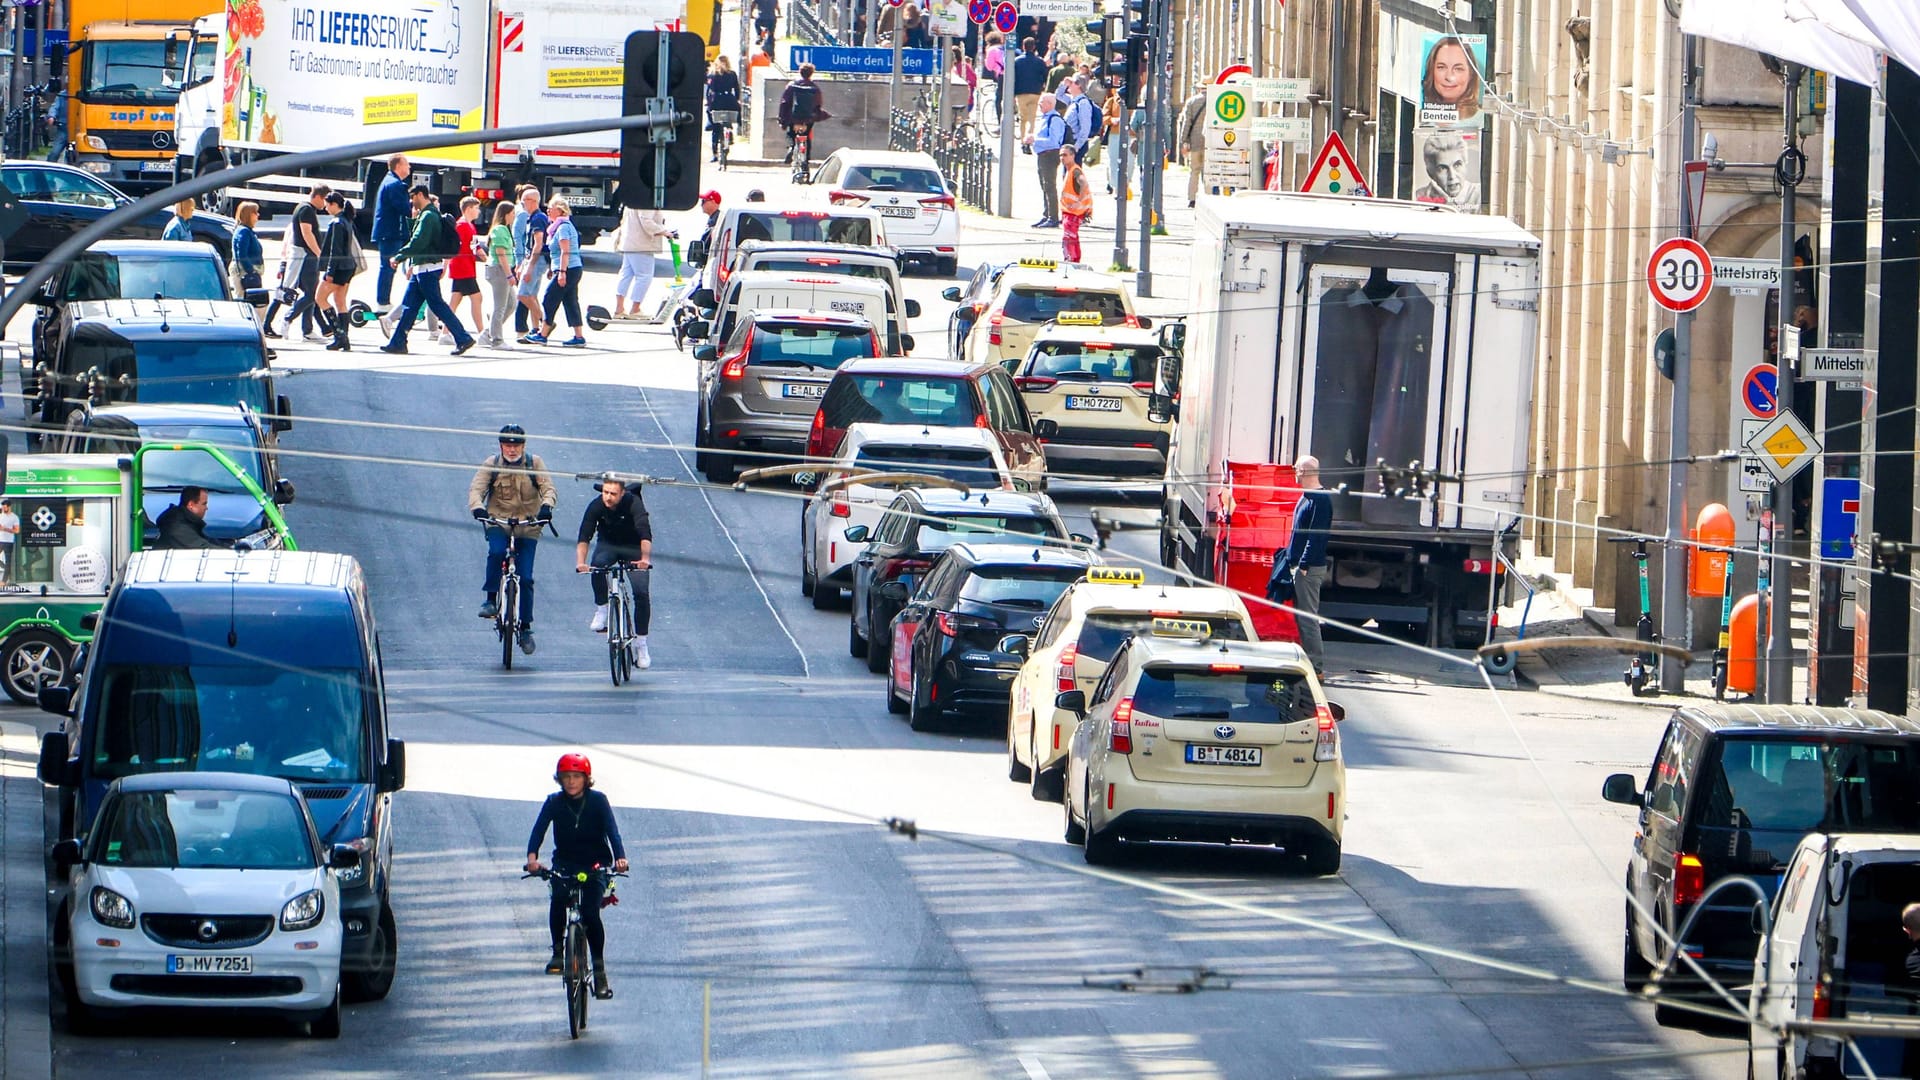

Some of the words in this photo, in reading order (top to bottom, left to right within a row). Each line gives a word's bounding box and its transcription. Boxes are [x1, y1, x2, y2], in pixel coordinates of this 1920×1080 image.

[1027, 2, 1050, 12] Unter
[1052, 2, 1062, 12] den
[1064, 3, 1088, 12] Linden
[292, 8, 315, 42] IHR
[319, 10, 428, 52] LIEFERSERVICE
[542, 45, 556, 54] IHR
[558, 46, 616, 56] LIEFERSERVICE
[832, 54, 861, 66] Unter
[864, 55, 884, 66] den
[887, 56, 922, 68] Lden
[289, 50, 306, 73] Für
[306, 52, 362, 78] Gastronomie
[364, 58, 381, 79] und
[384, 58, 458, 86] Großverbraucher
[1424, 102, 1456, 112] Hildegard
[109, 109, 144, 124] zapf
[432, 112, 459, 125] METRO
[1423, 111, 1457, 122] Bentele
[1661, 258, 1699, 291] 30
[791, 386, 797, 394] E
[803, 386, 814, 396] AL
[1072, 398, 1078, 407] B
[1100, 398, 1120, 408] 7278
[1098, 569, 1135, 580] TAXI
[1162, 621, 1200, 632] TAXI
[1198, 747, 1206, 760] B
[1214, 748, 1222, 761] T
[1224, 748, 1256, 762] 4814
[176, 957, 184, 970] B
[194, 957, 212, 970] MV
[215, 957, 250, 971] 7251
